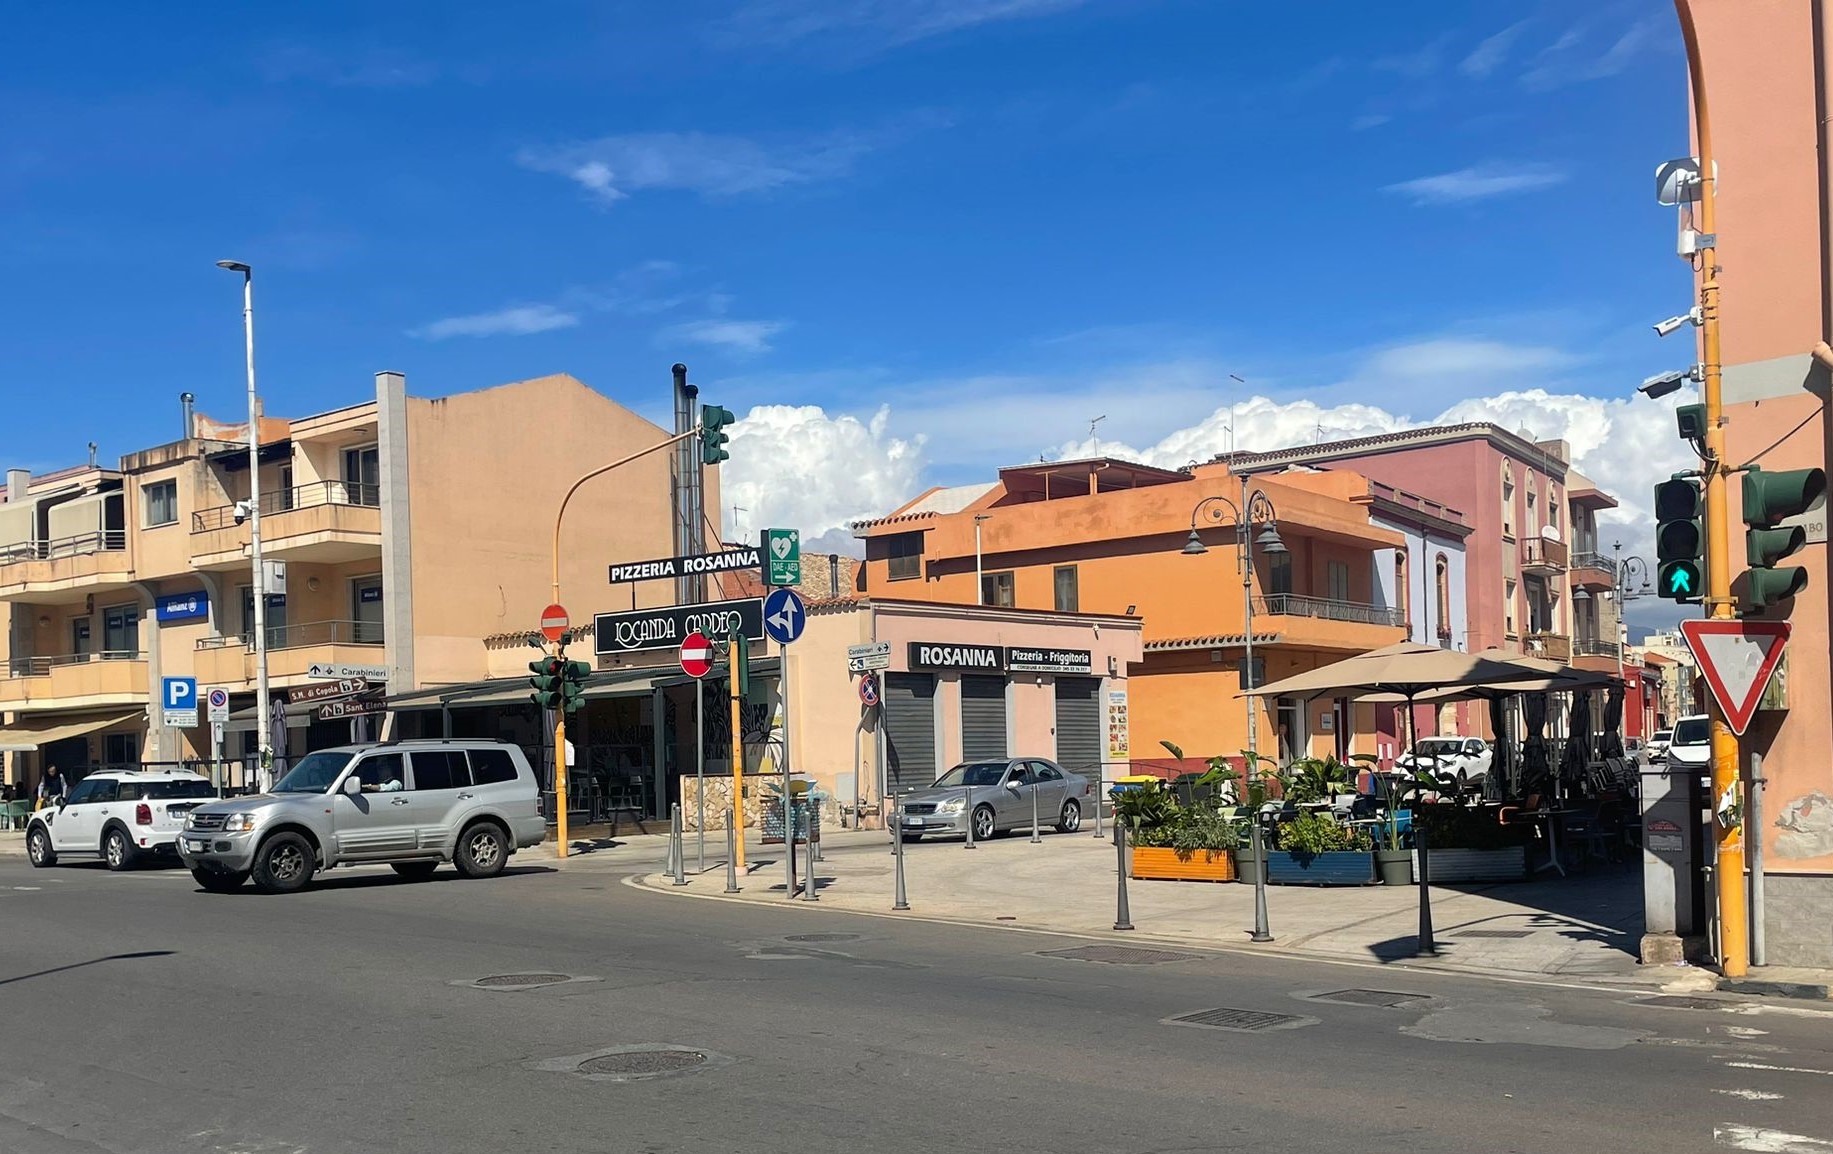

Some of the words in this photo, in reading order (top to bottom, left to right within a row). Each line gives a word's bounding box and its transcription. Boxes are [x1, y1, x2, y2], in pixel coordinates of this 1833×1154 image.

[611, 561, 675, 581] PIZZERIA
[683, 551, 760, 574] ROSANNA
[773, 562, 784, 571] DAE
[787, 563, 798, 572] AED
[615, 617, 676, 648] LOCANDA
[919, 646, 997, 668] ROSANNA
[1012, 650, 1043, 662] Pizzeria
[1049, 652, 1089, 665] Friggitoria
[341, 668, 386, 677] Carabinieri
[170, 681, 190, 705] P
[291, 691, 306, 700] S.M.
[308, 688, 314, 698] di
